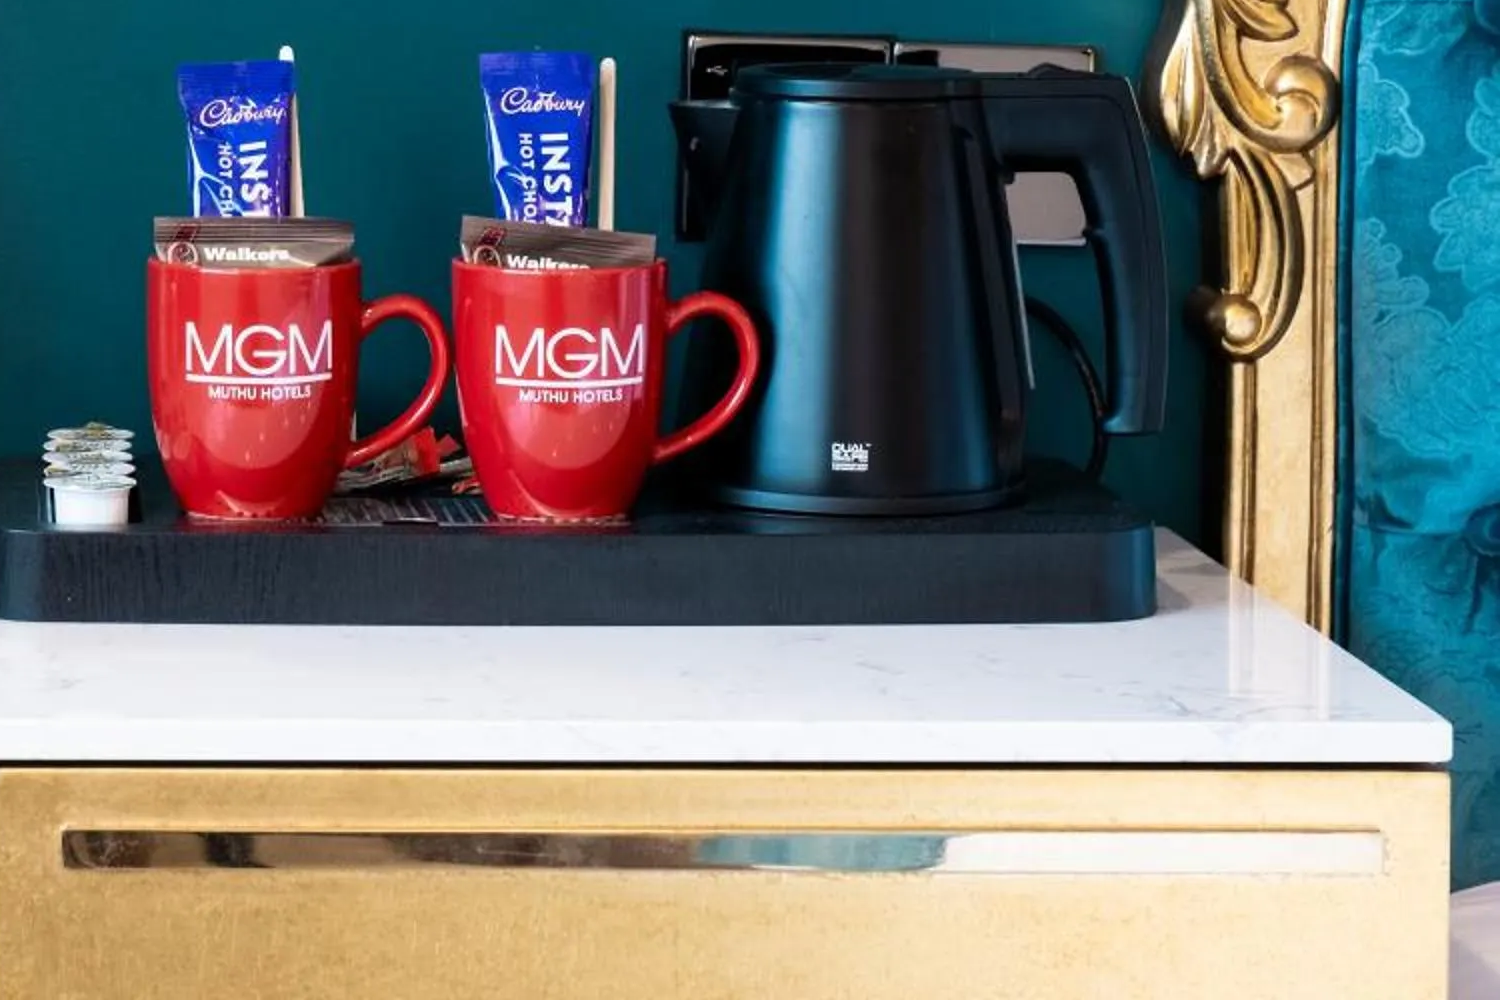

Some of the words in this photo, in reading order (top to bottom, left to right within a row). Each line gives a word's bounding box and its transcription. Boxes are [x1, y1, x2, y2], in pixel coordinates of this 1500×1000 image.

[200, 96, 286, 128] Cadbury
[500, 86, 585, 116] Cadbury
[217, 143, 233, 179] HOT
[518, 133, 535, 170] HOT
[202, 247, 290, 262] Walkers
[185, 319, 333, 376] MGM
[495, 323, 644, 379] MGM
[208, 384, 257, 400] MUTHU
[261, 384, 312, 400] HOTELS
[519, 388, 569, 403] MUTHU
[573, 388, 623, 404] HOTELS
[832, 442, 863, 452] DUAL
